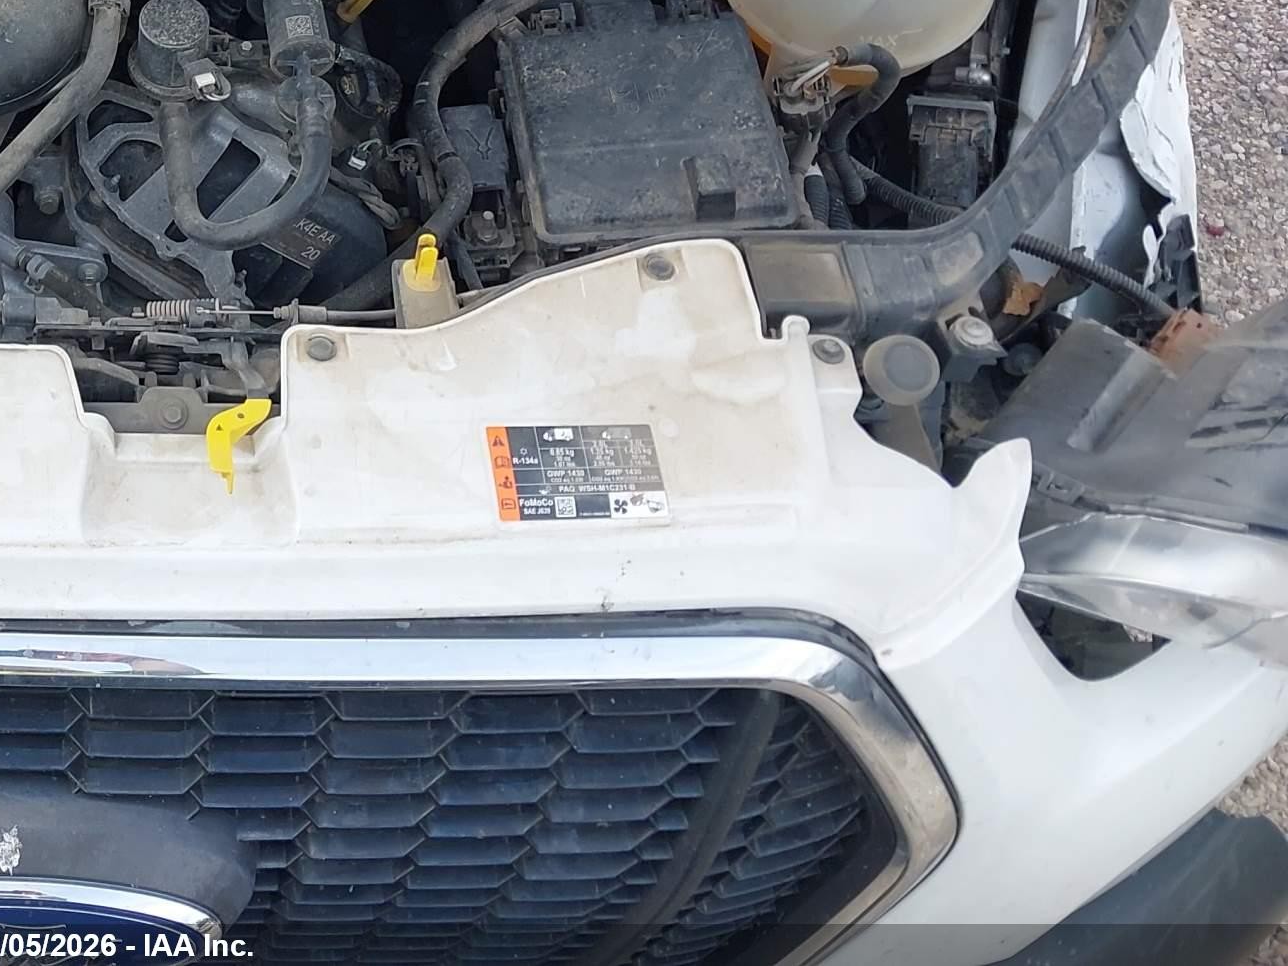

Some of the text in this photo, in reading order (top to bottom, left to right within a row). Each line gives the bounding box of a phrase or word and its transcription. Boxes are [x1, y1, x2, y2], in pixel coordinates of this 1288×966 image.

[300, 246, 321, 260] 20
[512, 456, 539, 465] R-134a
[519, 497, 554, 507] FoMoCo
